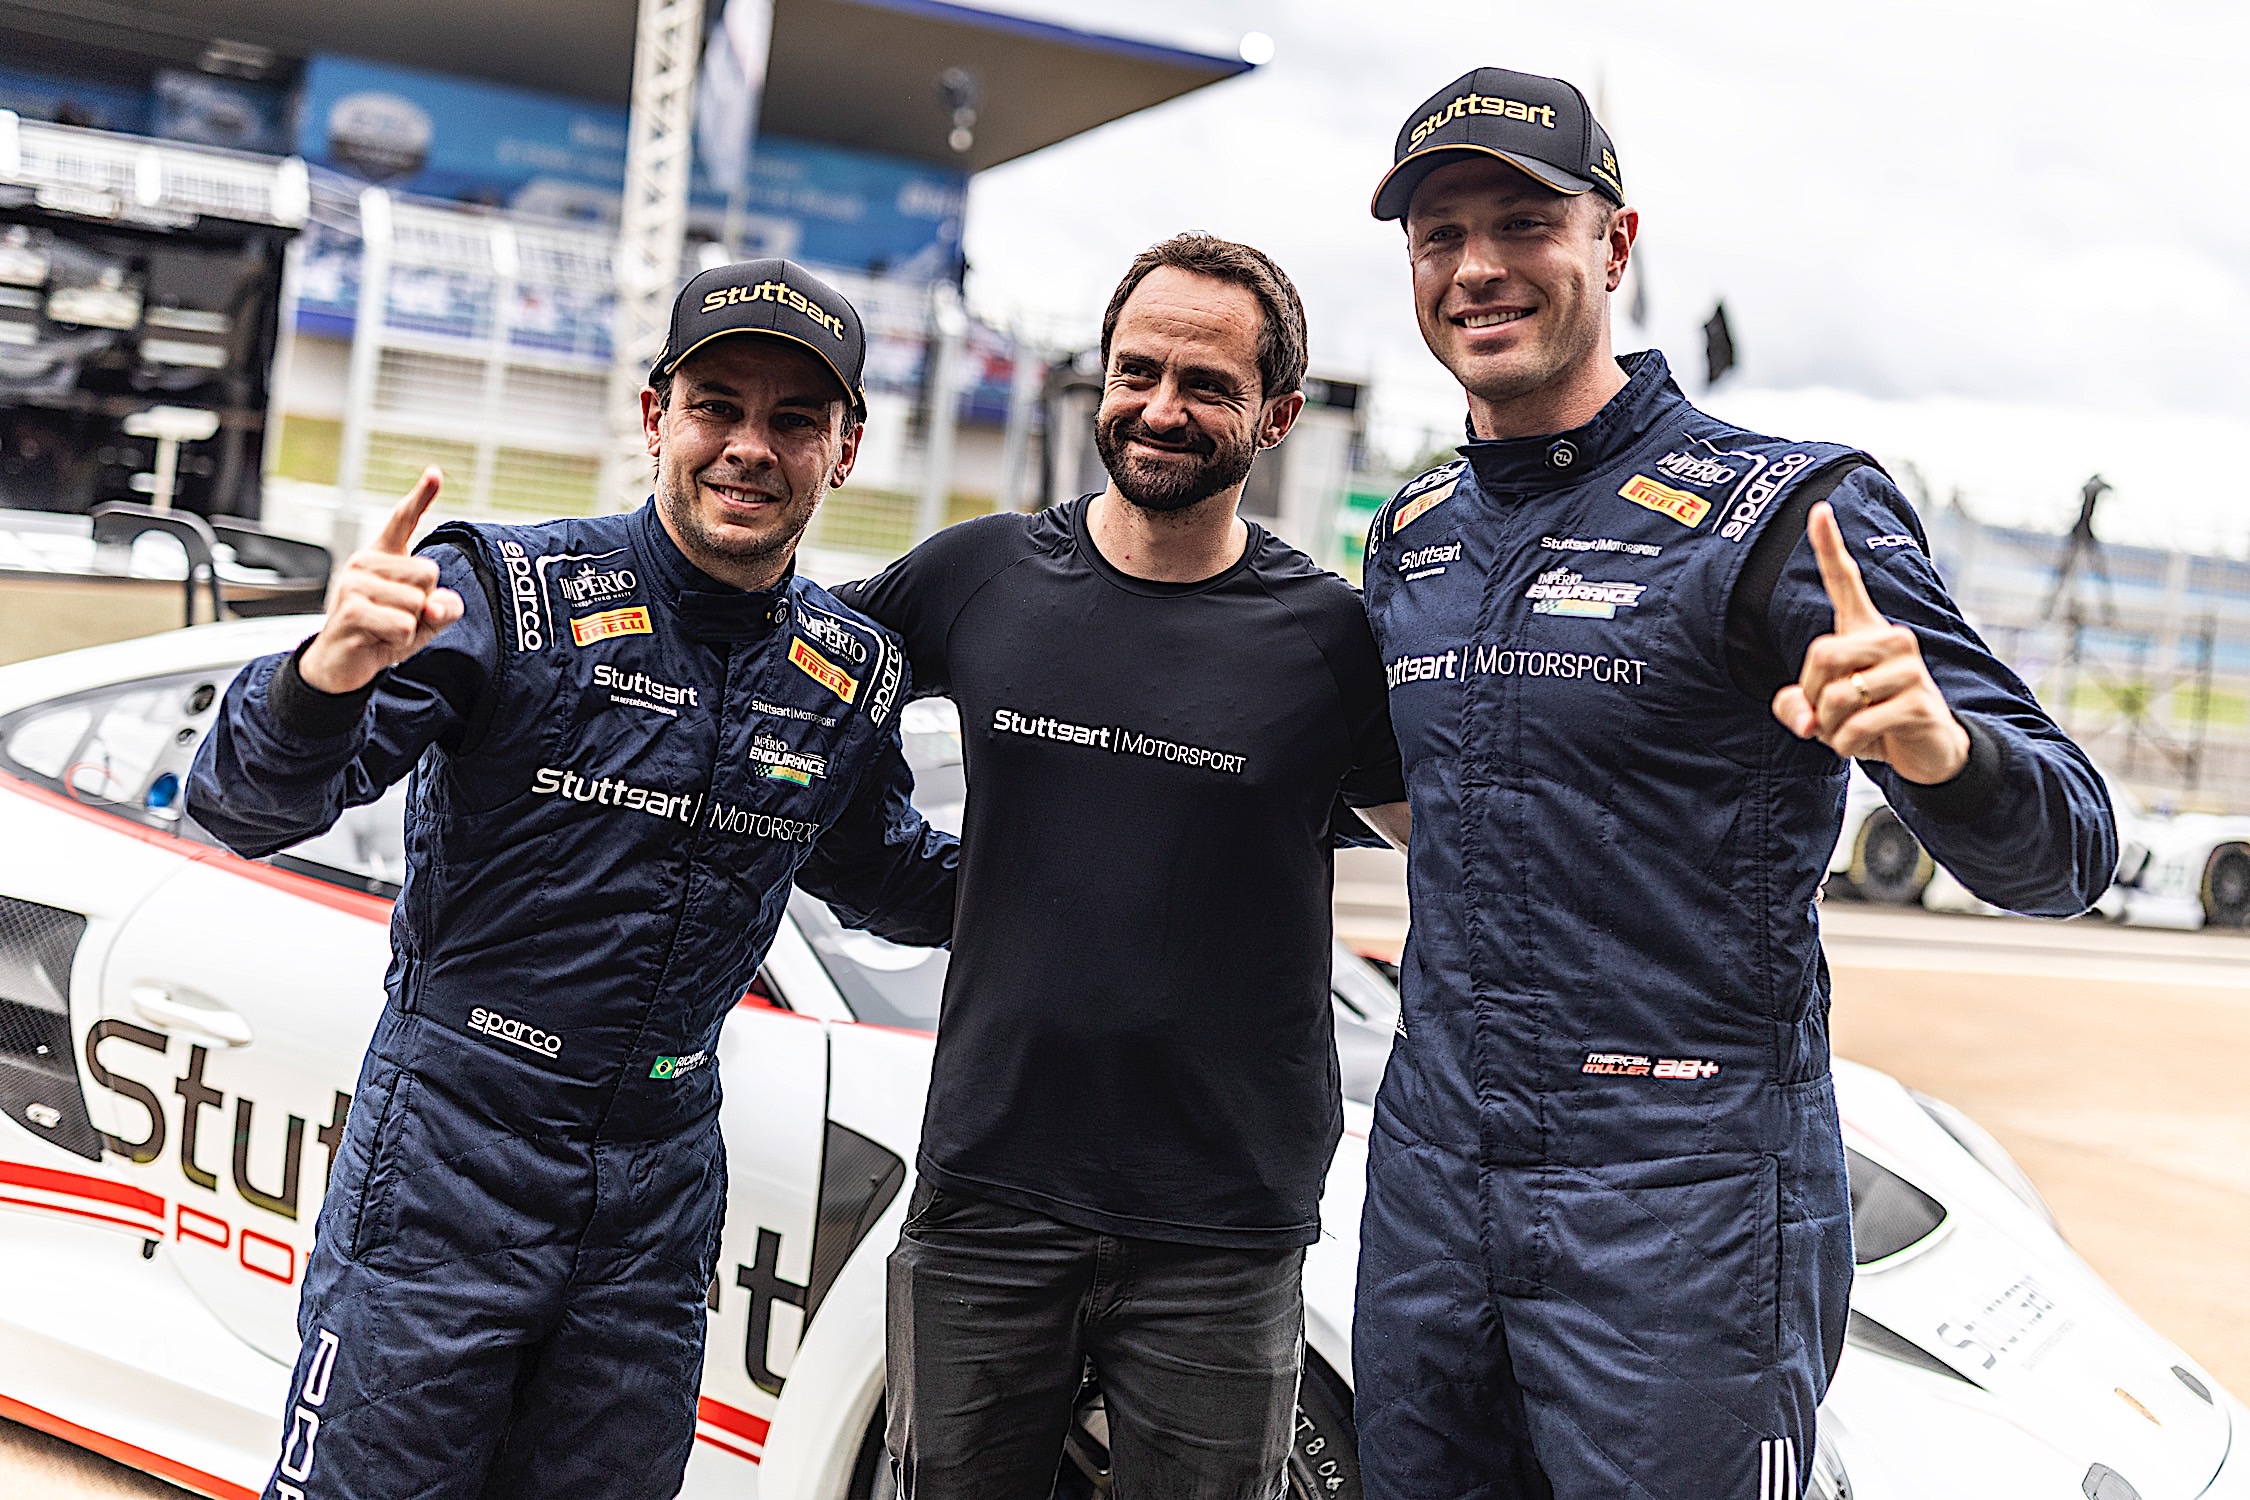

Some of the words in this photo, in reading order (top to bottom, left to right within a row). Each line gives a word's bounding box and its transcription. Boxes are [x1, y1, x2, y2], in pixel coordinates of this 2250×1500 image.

[1408, 93, 1555, 152] Stuttgart
[701, 281, 844, 341] Stuttgart
[1629, 481, 1702, 520] PIRELLI
[1721, 453, 1816, 542] sparco
[497, 540, 542, 651] sparco
[574, 612, 645, 642] PIRELLI
[594, 665, 698, 706] Stuttgart
[795, 644, 851, 697] PIRELLI
[1474, 645, 1648, 684] MOTORSPORT
[749, 747, 825, 775] ENDURANCE
[994, 709, 1110, 748] Stuttgart
[1122, 733, 1246, 773] MOTORSPORT
[532, 768, 692, 822] Stuttgart
[467, 1008, 561, 1054] sparco
